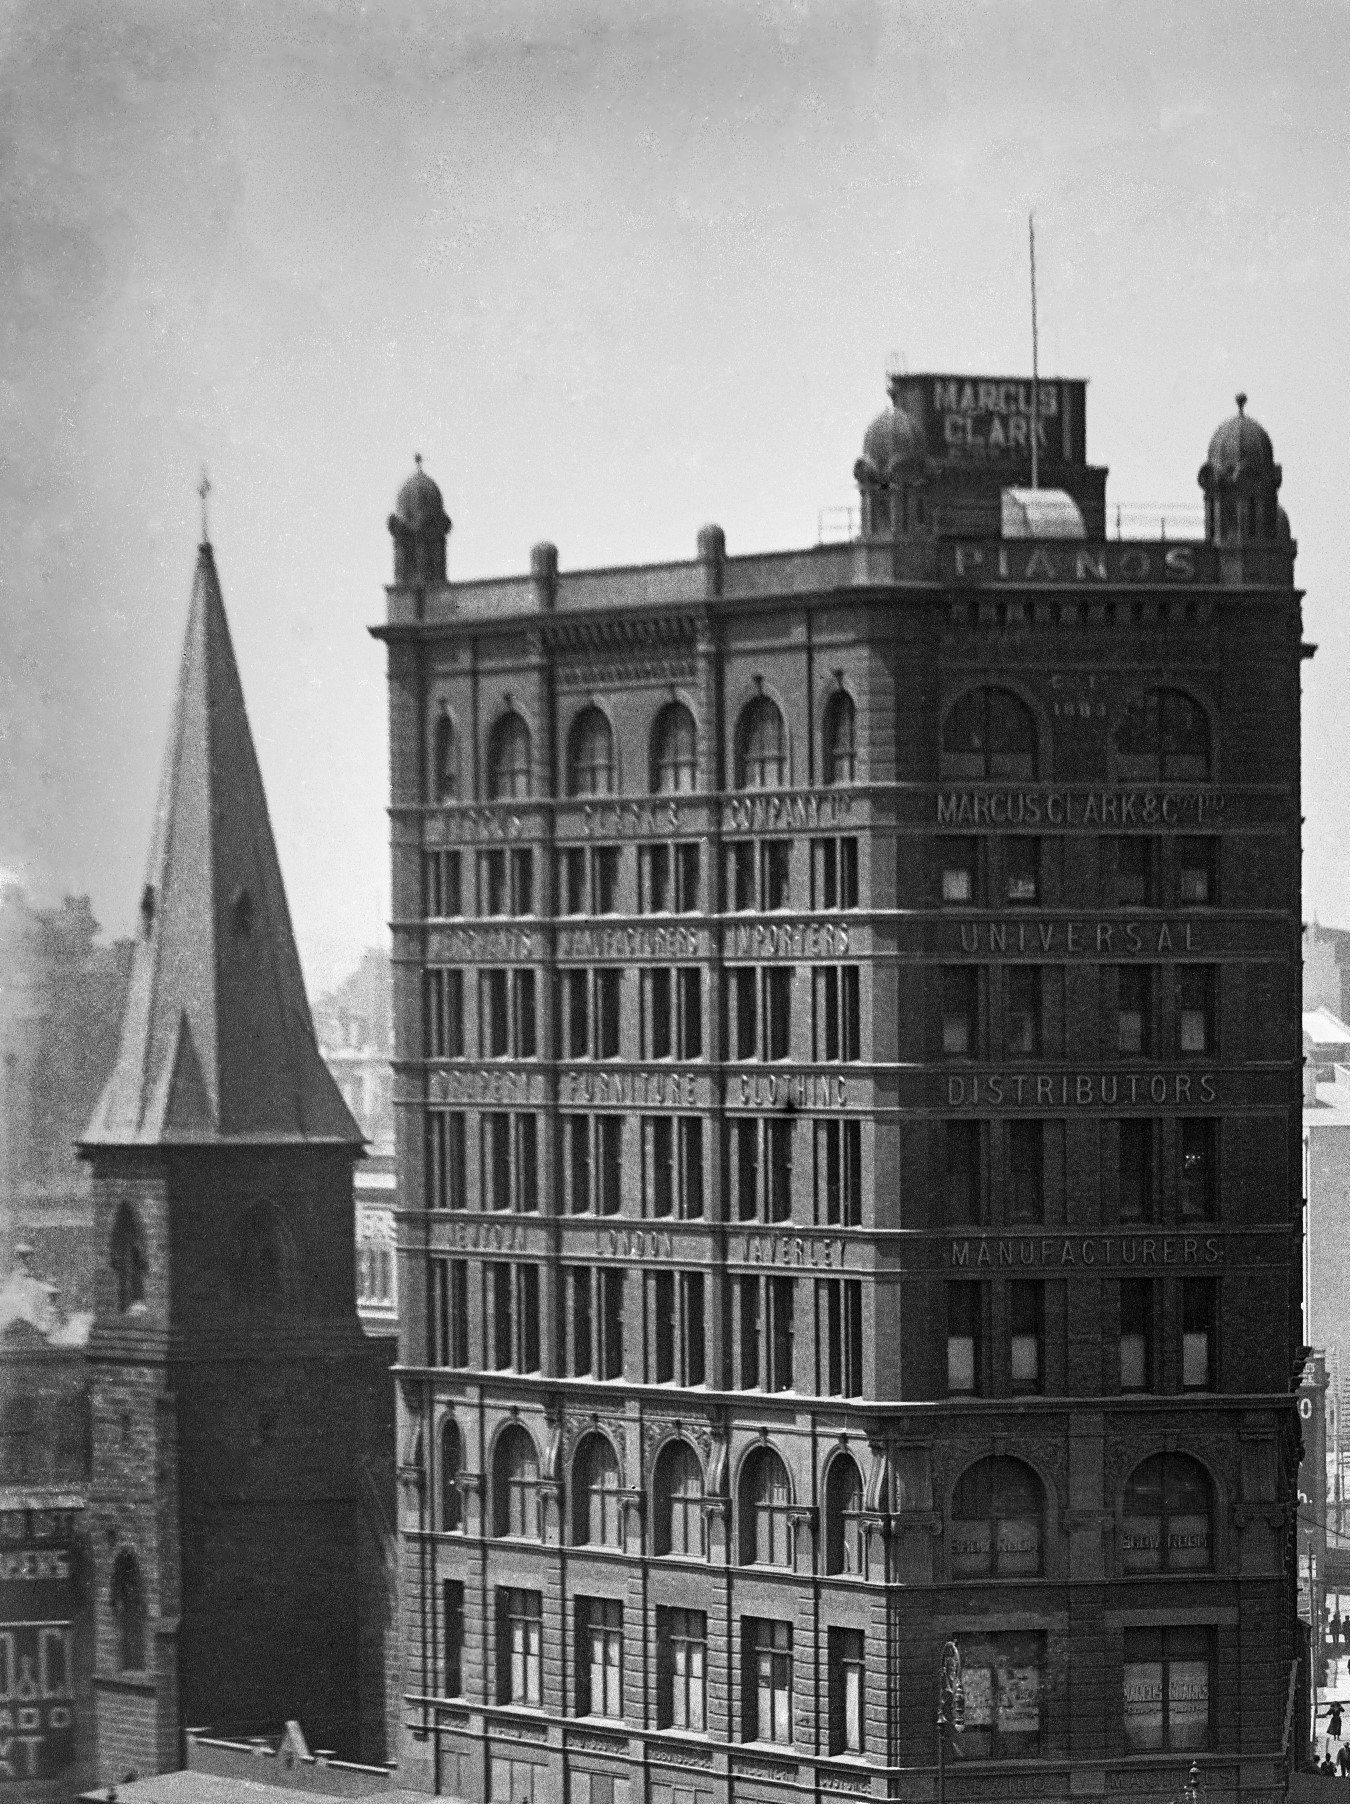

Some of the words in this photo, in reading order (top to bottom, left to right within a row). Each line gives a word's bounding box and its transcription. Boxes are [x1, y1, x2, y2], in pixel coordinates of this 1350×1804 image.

[934, 381, 1059, 417] MARCUS
[943, 413, 1047, 447] CLARK
[954, 545, 1198, 581] PIANOS
[937, 792, 1040, 824] MARCUS
[1046, 791, 1137, 824] CLARK
[1141, 790, 1160, 824] &
[733, 922, 850, 958] IMPORTERS
[960, 921, 1200, 953] UNIVERSAL
[569, 1071, 696, 1106] FURNITURE
[739, 1073, 848, 1107] CLOTHING
[948, 1073, 1217, 1105] DISTRIBUTORS
[595, 1228, 674, 1258] LONDON
[742, 1233, 848, 1267] WAVERLEY
[951, 1237, 1222, 1267] MANUFACTURERS
[1110, 1768, 1231, 1791] MACHIES
